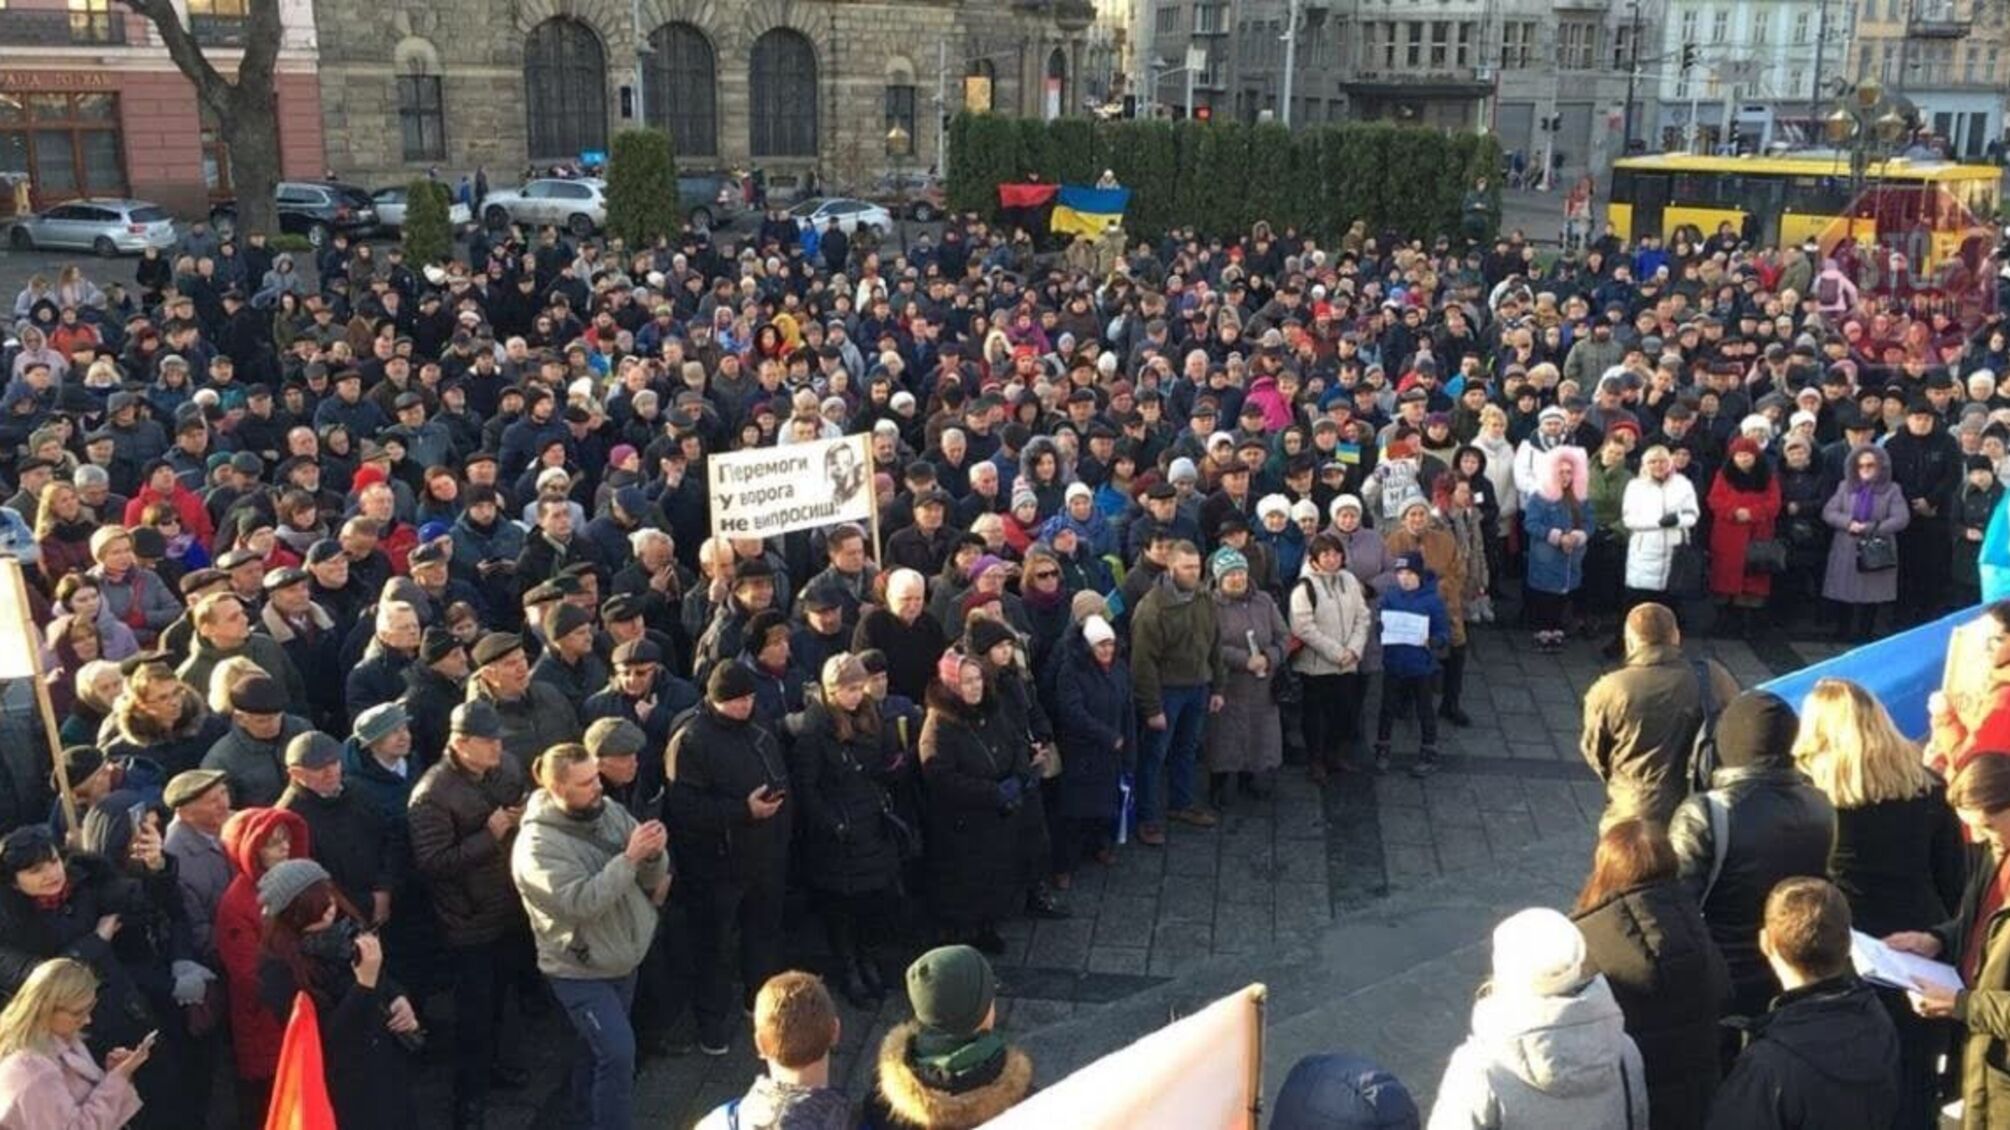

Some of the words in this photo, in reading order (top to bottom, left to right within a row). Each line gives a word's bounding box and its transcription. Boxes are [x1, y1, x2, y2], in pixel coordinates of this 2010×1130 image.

[718, 456, 808, 484] Перемоги
[740, 483, 795, 506] ворога
[720, 516, 749, 532] не
